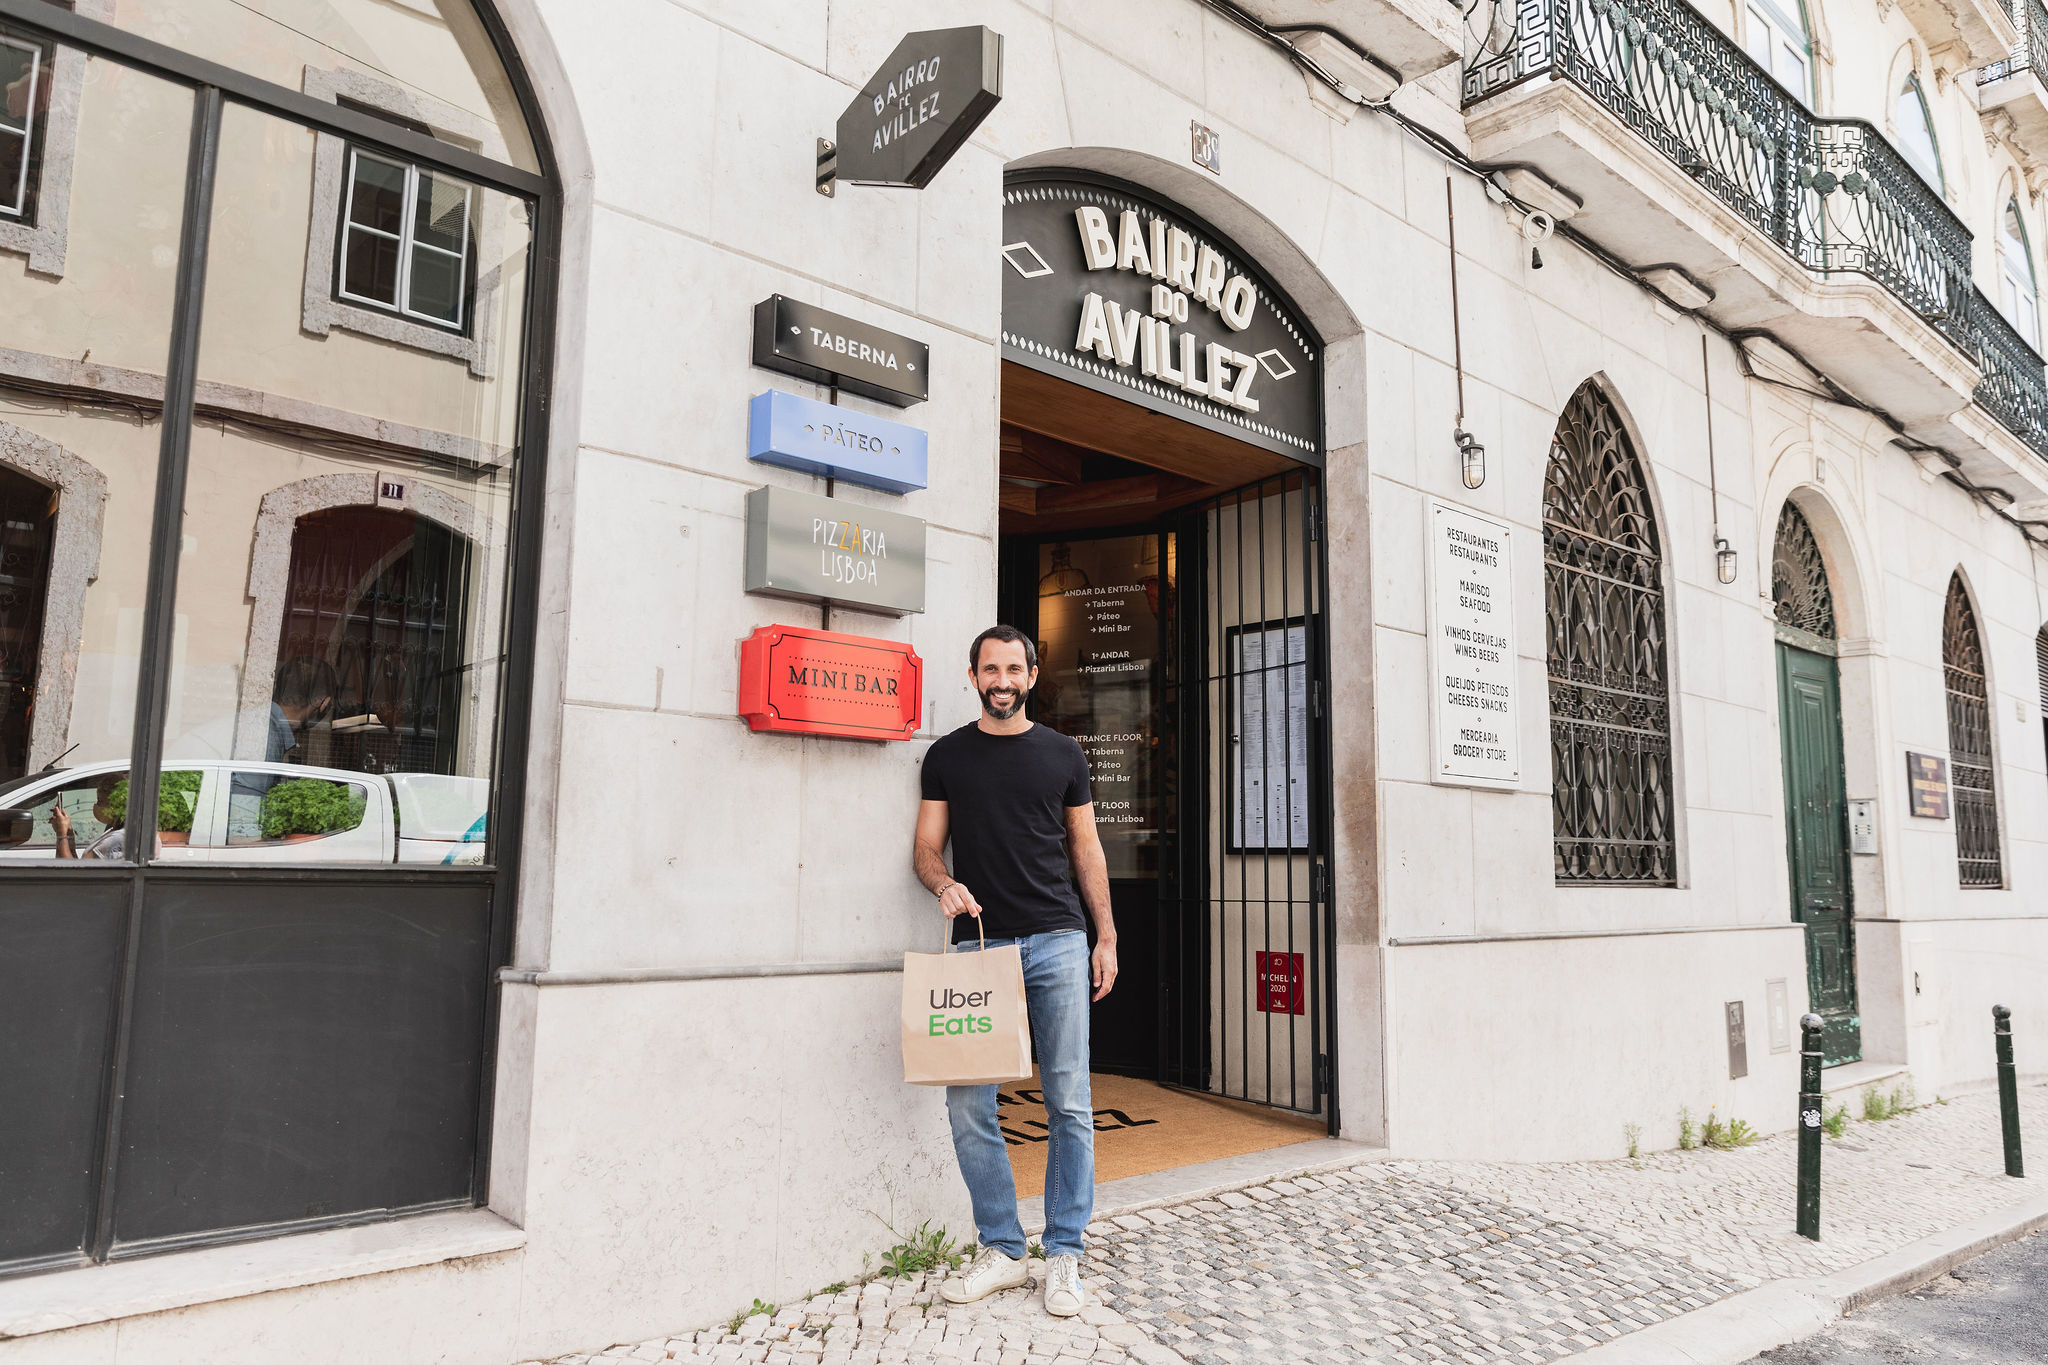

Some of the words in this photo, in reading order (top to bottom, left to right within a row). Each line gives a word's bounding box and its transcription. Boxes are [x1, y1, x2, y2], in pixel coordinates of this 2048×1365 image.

[872, 56, 941, 117] BAIRRO
[871, 91, 940, 154] AVILLEZ
[1075, 206, 1257, 332] BAIRRO
[1152, 284, 1189, 325] DO
[810, 327, 898, 371] TABERNA
[1075, 291, 1260, 413] AVILLEZ
[822, 423, 883, 454] PÁTEO
[813, 518, 887, 559] PIZZARIA
[1447, 527, 1499, 553] RESTAURANTES
[1449, 543, 1498, 568] RESTAURANTS
[821, 549, 878, 587] LISBOA
[1064, 587, 1092, 597] ANDAR
[1094, 587, 1106, 595] DA
[1107, 584, 1147, 594] ENTRADA
[1459, 579, 1490, 598] MARISCO
[1091, 599, 1125, 608] Taberna
[1459, 595, 1491, 614] SEAFOOD
[1096, 612, 1121, 621] Páteo
[1098, 624, 1115, 633] Mini
[1117, 624, 1132, 632] Bar
[1445, 624, 1471, 643] VINHOS
[1472, 631, 1507, 649] CERVEJAS
[1100, 650, 1130, 659] ANDAR
[1454, 643, 1477, 659] WINES
[1478, 648, 1500, 663] BEERS
[1085, 664, 1116, 673] Pizzaria
[1117, 663, 1145, 672] Lisboa
[788, 665, 848, 691] MINI
[854, 673, 898, 697] BAR
[1445, 675, 1476, 692] QUEIJOS
[1477, 681, 1509, 698] PETISCOS
[1448, 692, 1479, 708] CHEESES
[1480, 698, 1508, 713] SNACKS
[1069, 735, 1112, 743] NTRANCE
[1113, 733, 1142, 742] FLOOR
[1460, 728, 1499, 744] MERCEARIA
[1091, 748, 1124, 756] Taberna
[1453, 743, 1484, 759] GROCERY
[1486, 748, 1507, 761] STORE
[1097, 760, 1121, 769] Páteo
[1097, 774, 1115, 782] Mini
[1116, 774, 1131, 782] Bar
[1101, 801, 1130, 809] FLOOR
[1095, 814, 1115, 823] zaria
[1117, 814, 1144, 823] Lisboa
[1261, 973, 1297, 983] MCHELN
[1270, 984, 1287, 993] 2020
[930, 988, 993, 1009] Uber
[929, 1013, 993, 1036] Eats
